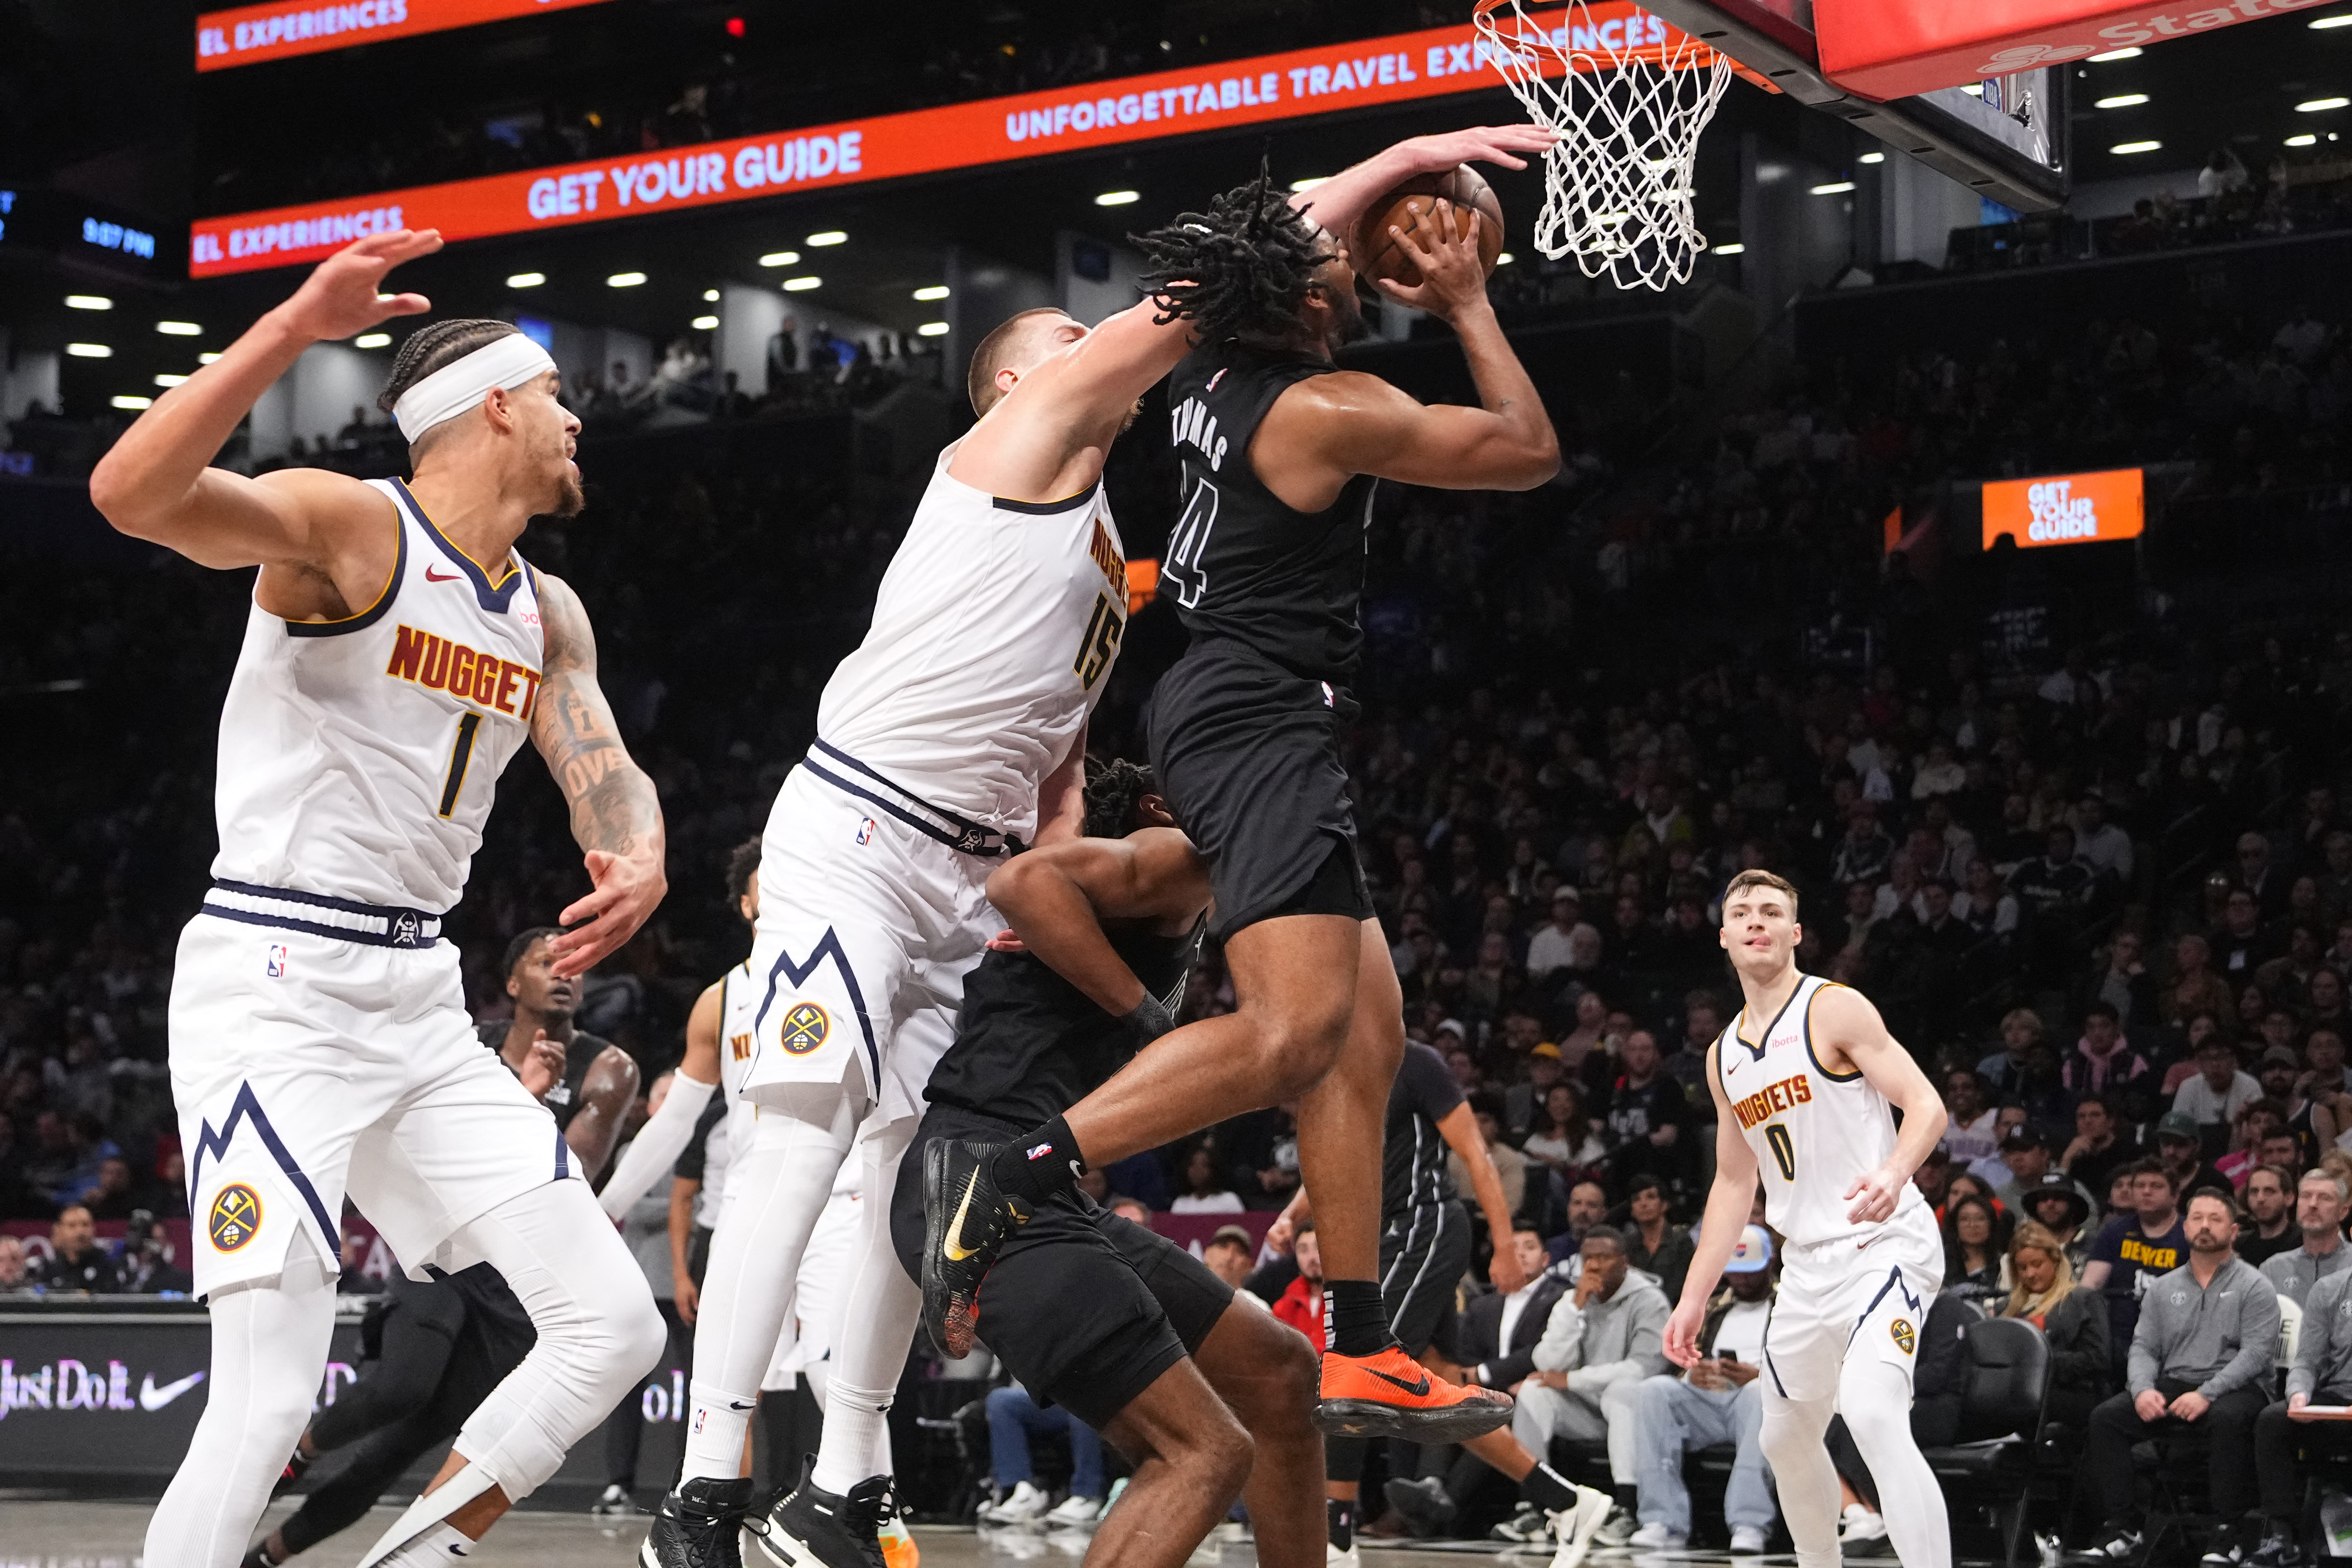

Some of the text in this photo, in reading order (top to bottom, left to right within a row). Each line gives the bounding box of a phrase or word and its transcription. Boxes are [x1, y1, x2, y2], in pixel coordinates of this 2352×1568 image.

[199, 0, 408, 57] EL EXPERIENCES
[2098, 0, 2319, 47] Stat
[1006, 72, 1279, 142] UNFORGETTABLE
[1288, 53, 1416, 99] TRAVEL
[528, 131, 862, 220] GET YOUR GUIDE
[193, 205, 403, 263] EL EXPERIENCES
[2027, 481, 2071, 505] GET
[2029, 497, 2094, 521] YOUR
[2028, 515, 2097, 541] GUIDE
[1073, 591, 1123, 692] 15
[438, 709, 483, 819] 1
[1771, 1035, 1798, 1049] ibotta
[1764, 1122, 1795, 1182] 0
